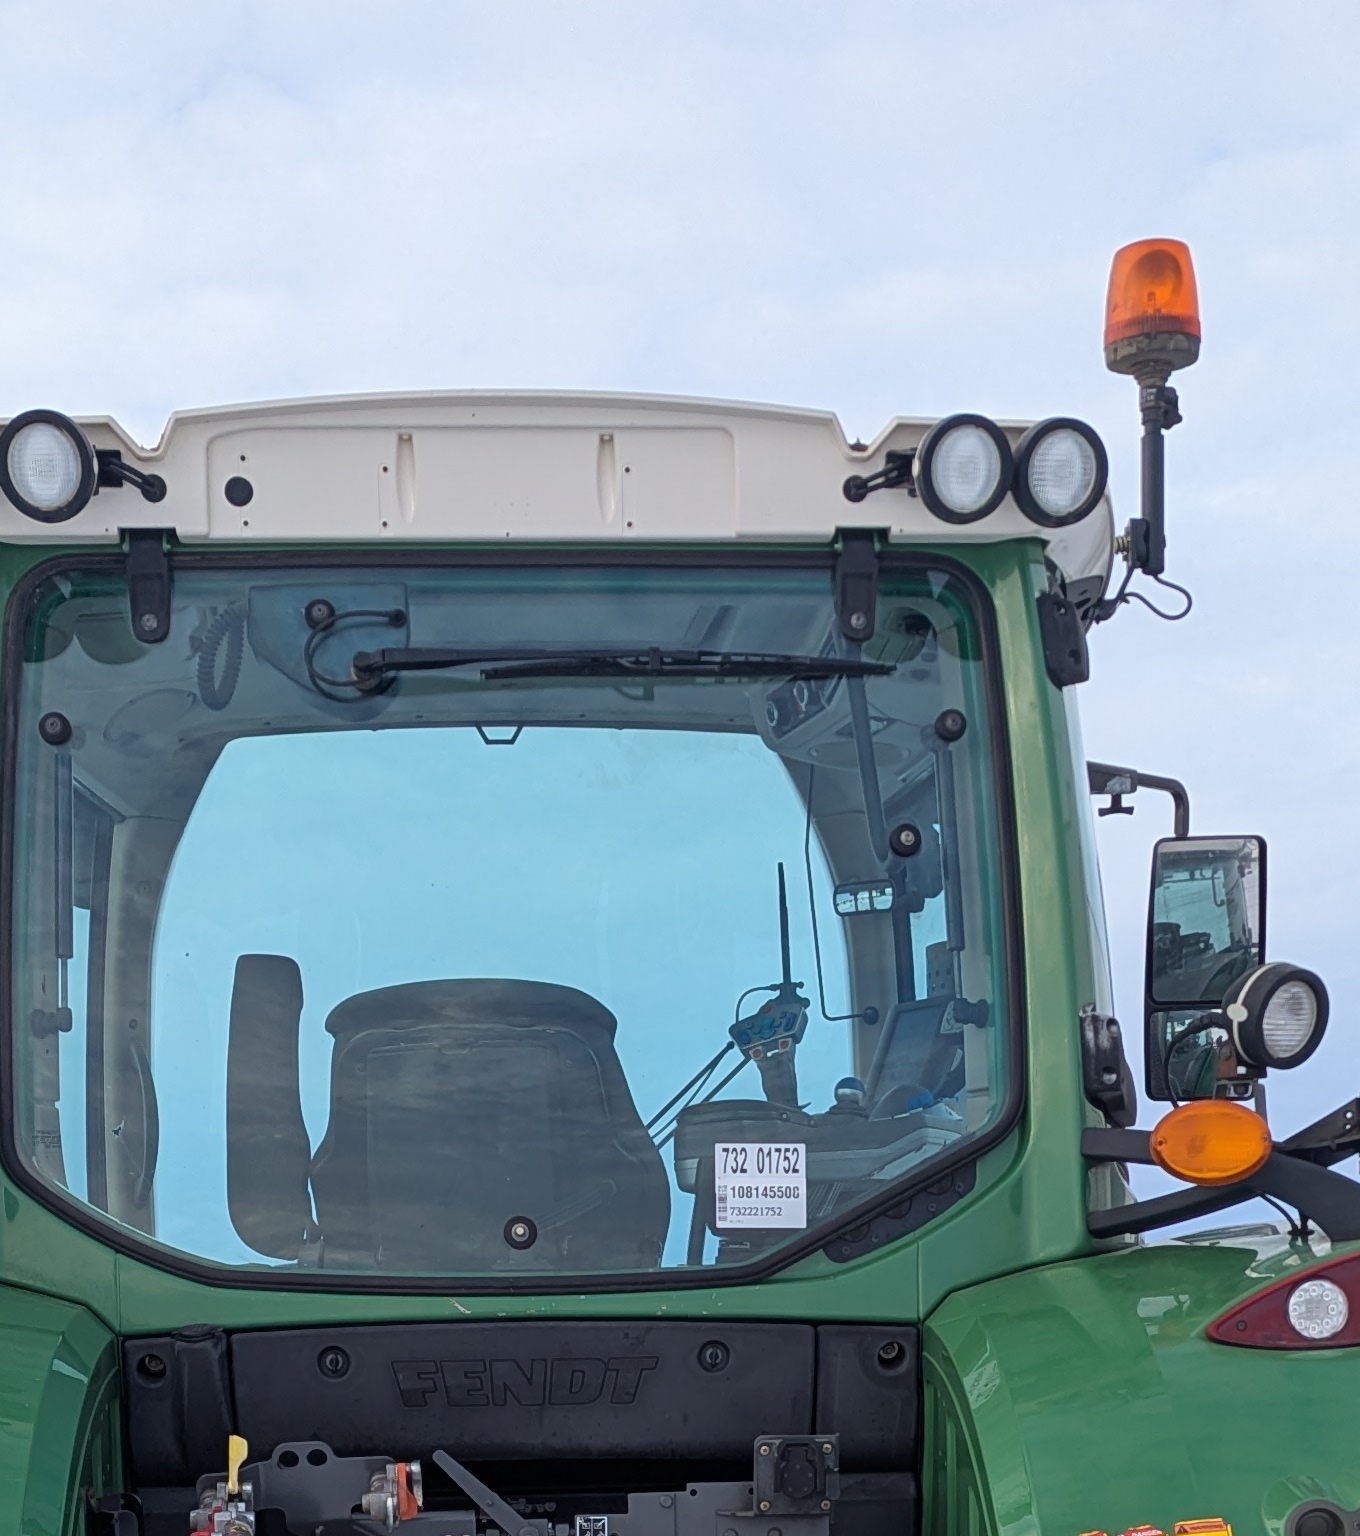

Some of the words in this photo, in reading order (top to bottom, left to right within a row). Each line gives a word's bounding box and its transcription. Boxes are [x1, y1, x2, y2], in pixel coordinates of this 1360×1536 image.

[722, 1147, 748, 1174] 732
[756, 1147, 800, 1174] 01752
[730, 1185, 800, 1199] 108145508
[729, 1206, 783, 1216] 732221752
[391, 1346, 660, 1407] FENDT
